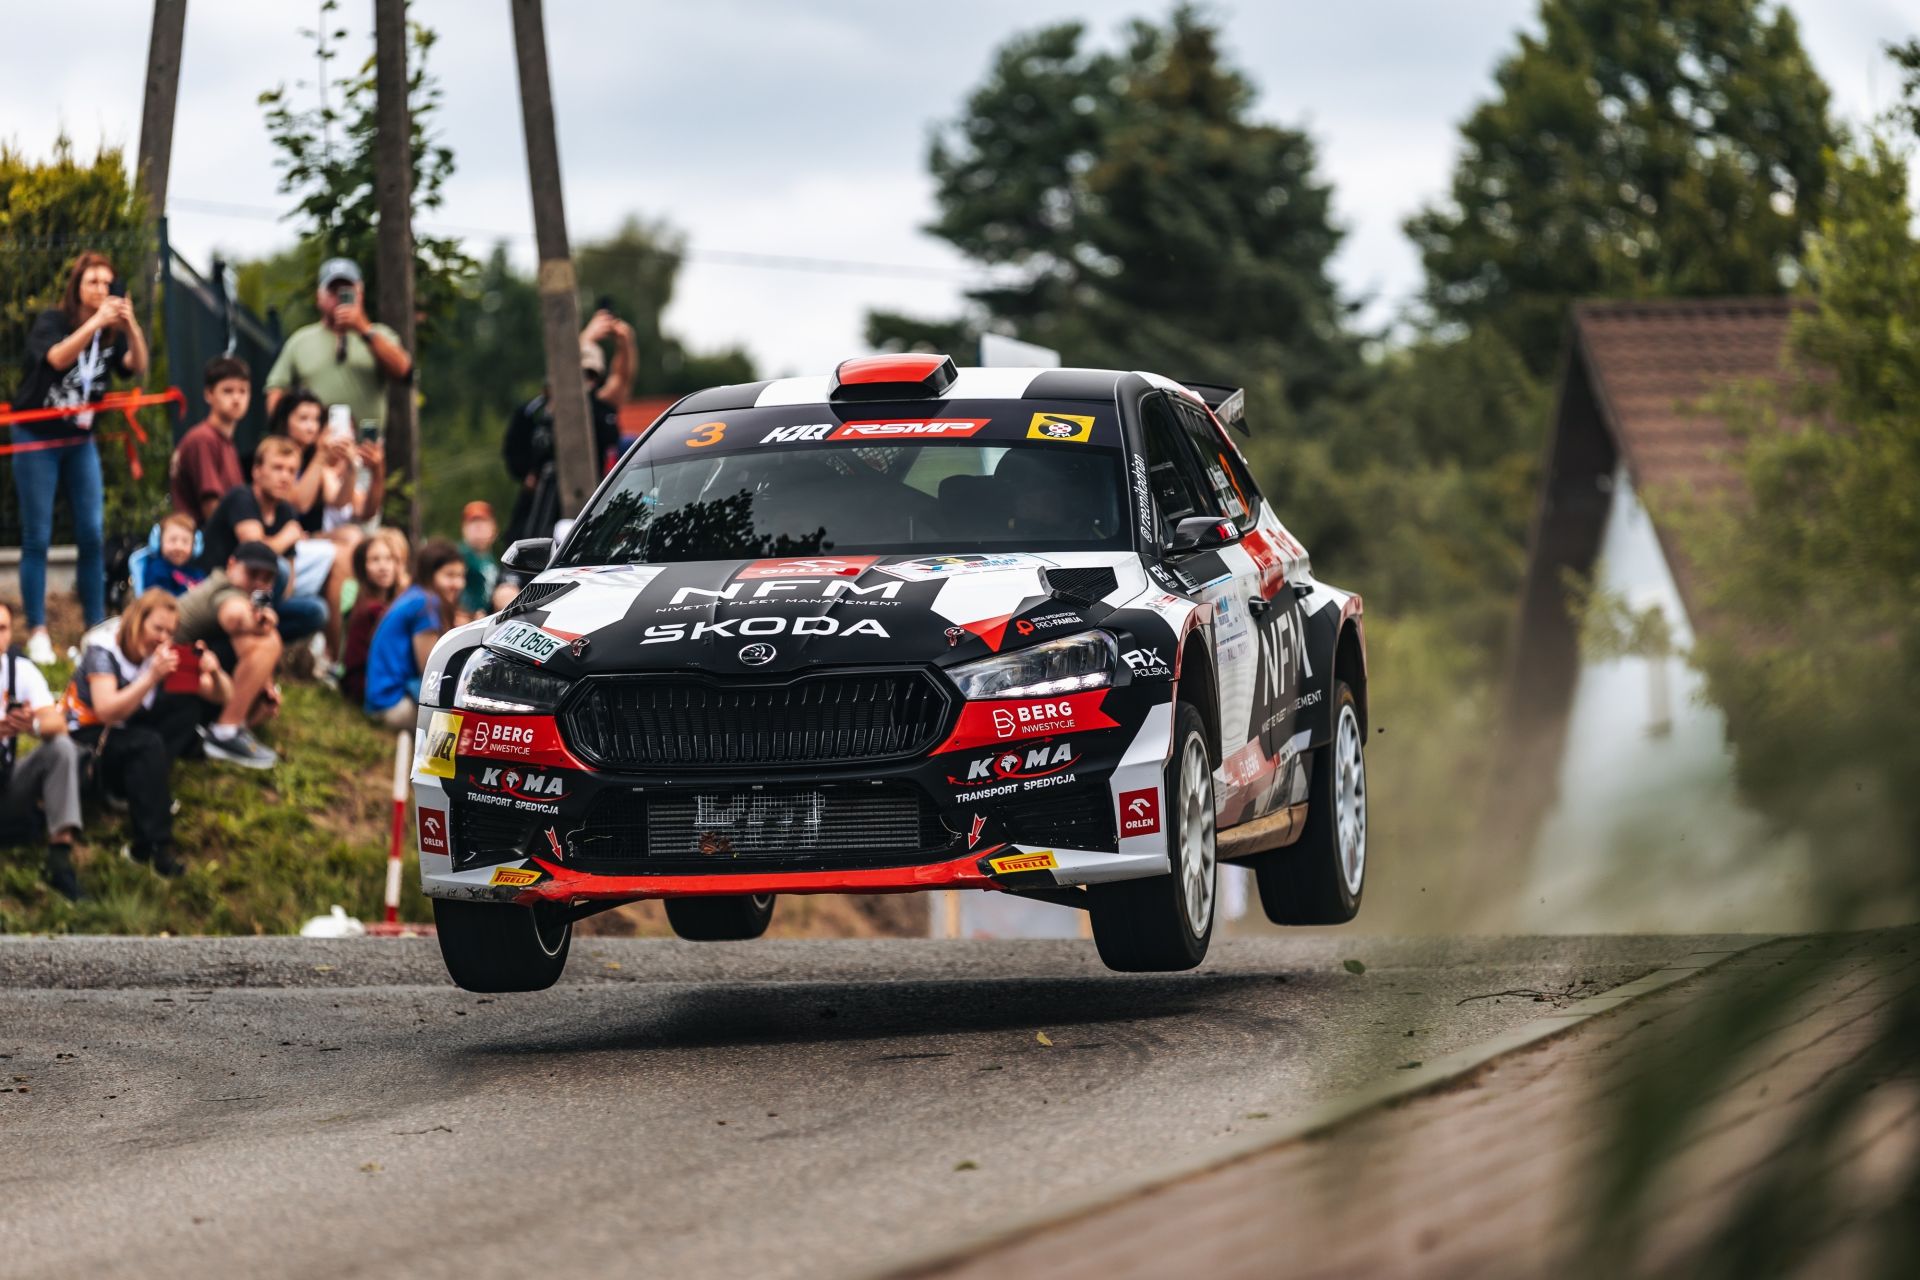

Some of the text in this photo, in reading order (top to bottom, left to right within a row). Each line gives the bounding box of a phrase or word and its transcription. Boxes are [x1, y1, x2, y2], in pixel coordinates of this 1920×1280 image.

[686, 422, 727, 447] 3
[841, 422, 976, 436] RSMP
[668, 580, 905, 605] NFM
[729, 598, 779, 606] FLEET
[520, 632, 561, 656] 0505
[1120, 648, 1168, 668] RX
[1260, 602, 1314, 707] NFM
[1134, 667, 1172, 678] POLSKA
[1017, 701, 1073, 722] BERG
[492, 725, 534, 743] BERG
[1021, 720, 1076, 734] INWESTYCJE
[490, 744, 531, 756] INWESTYCJE
[955, 773, 1076, 803] TRANSPORT SPEDYCJA
[467, 792, 559, 815] TRANSPORT SPEDYCJA
[1125, 818, 1154, 829] ORLEN
[423, 837, 444, 848] ORLEN
[997, 855, 1052, 871] PIRELLI
[495, 870, 535, 884] PIRELLI
